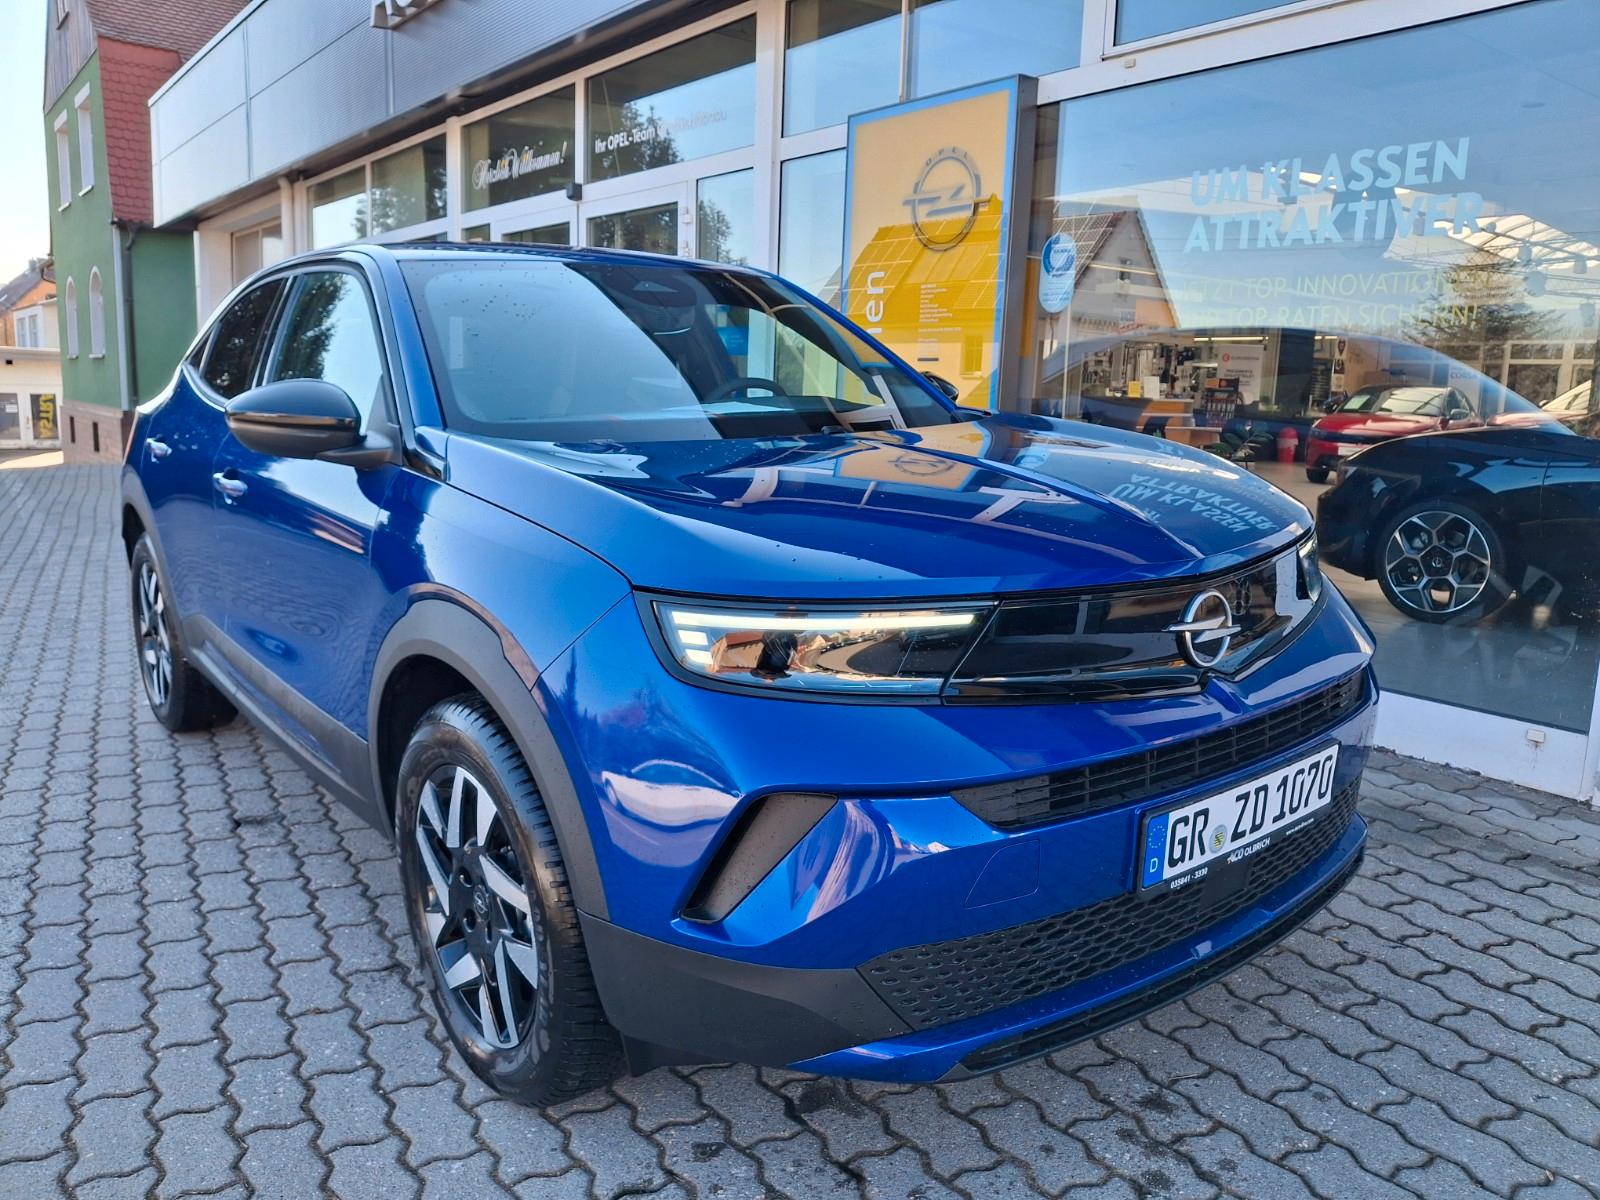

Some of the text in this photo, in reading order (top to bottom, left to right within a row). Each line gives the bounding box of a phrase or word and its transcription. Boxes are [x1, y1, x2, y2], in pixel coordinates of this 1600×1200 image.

[594, 138, 606, 154] Ihr
[1190, 137, 1470, 206] UM KLASSEN
[1248, 277, 1287, 298] TOP
[1168, 754, 1334, 868] GR ZD 1070
[1244, 837, 1271, 857] OLBRICH
[1149, 857, 1159, 873] D
